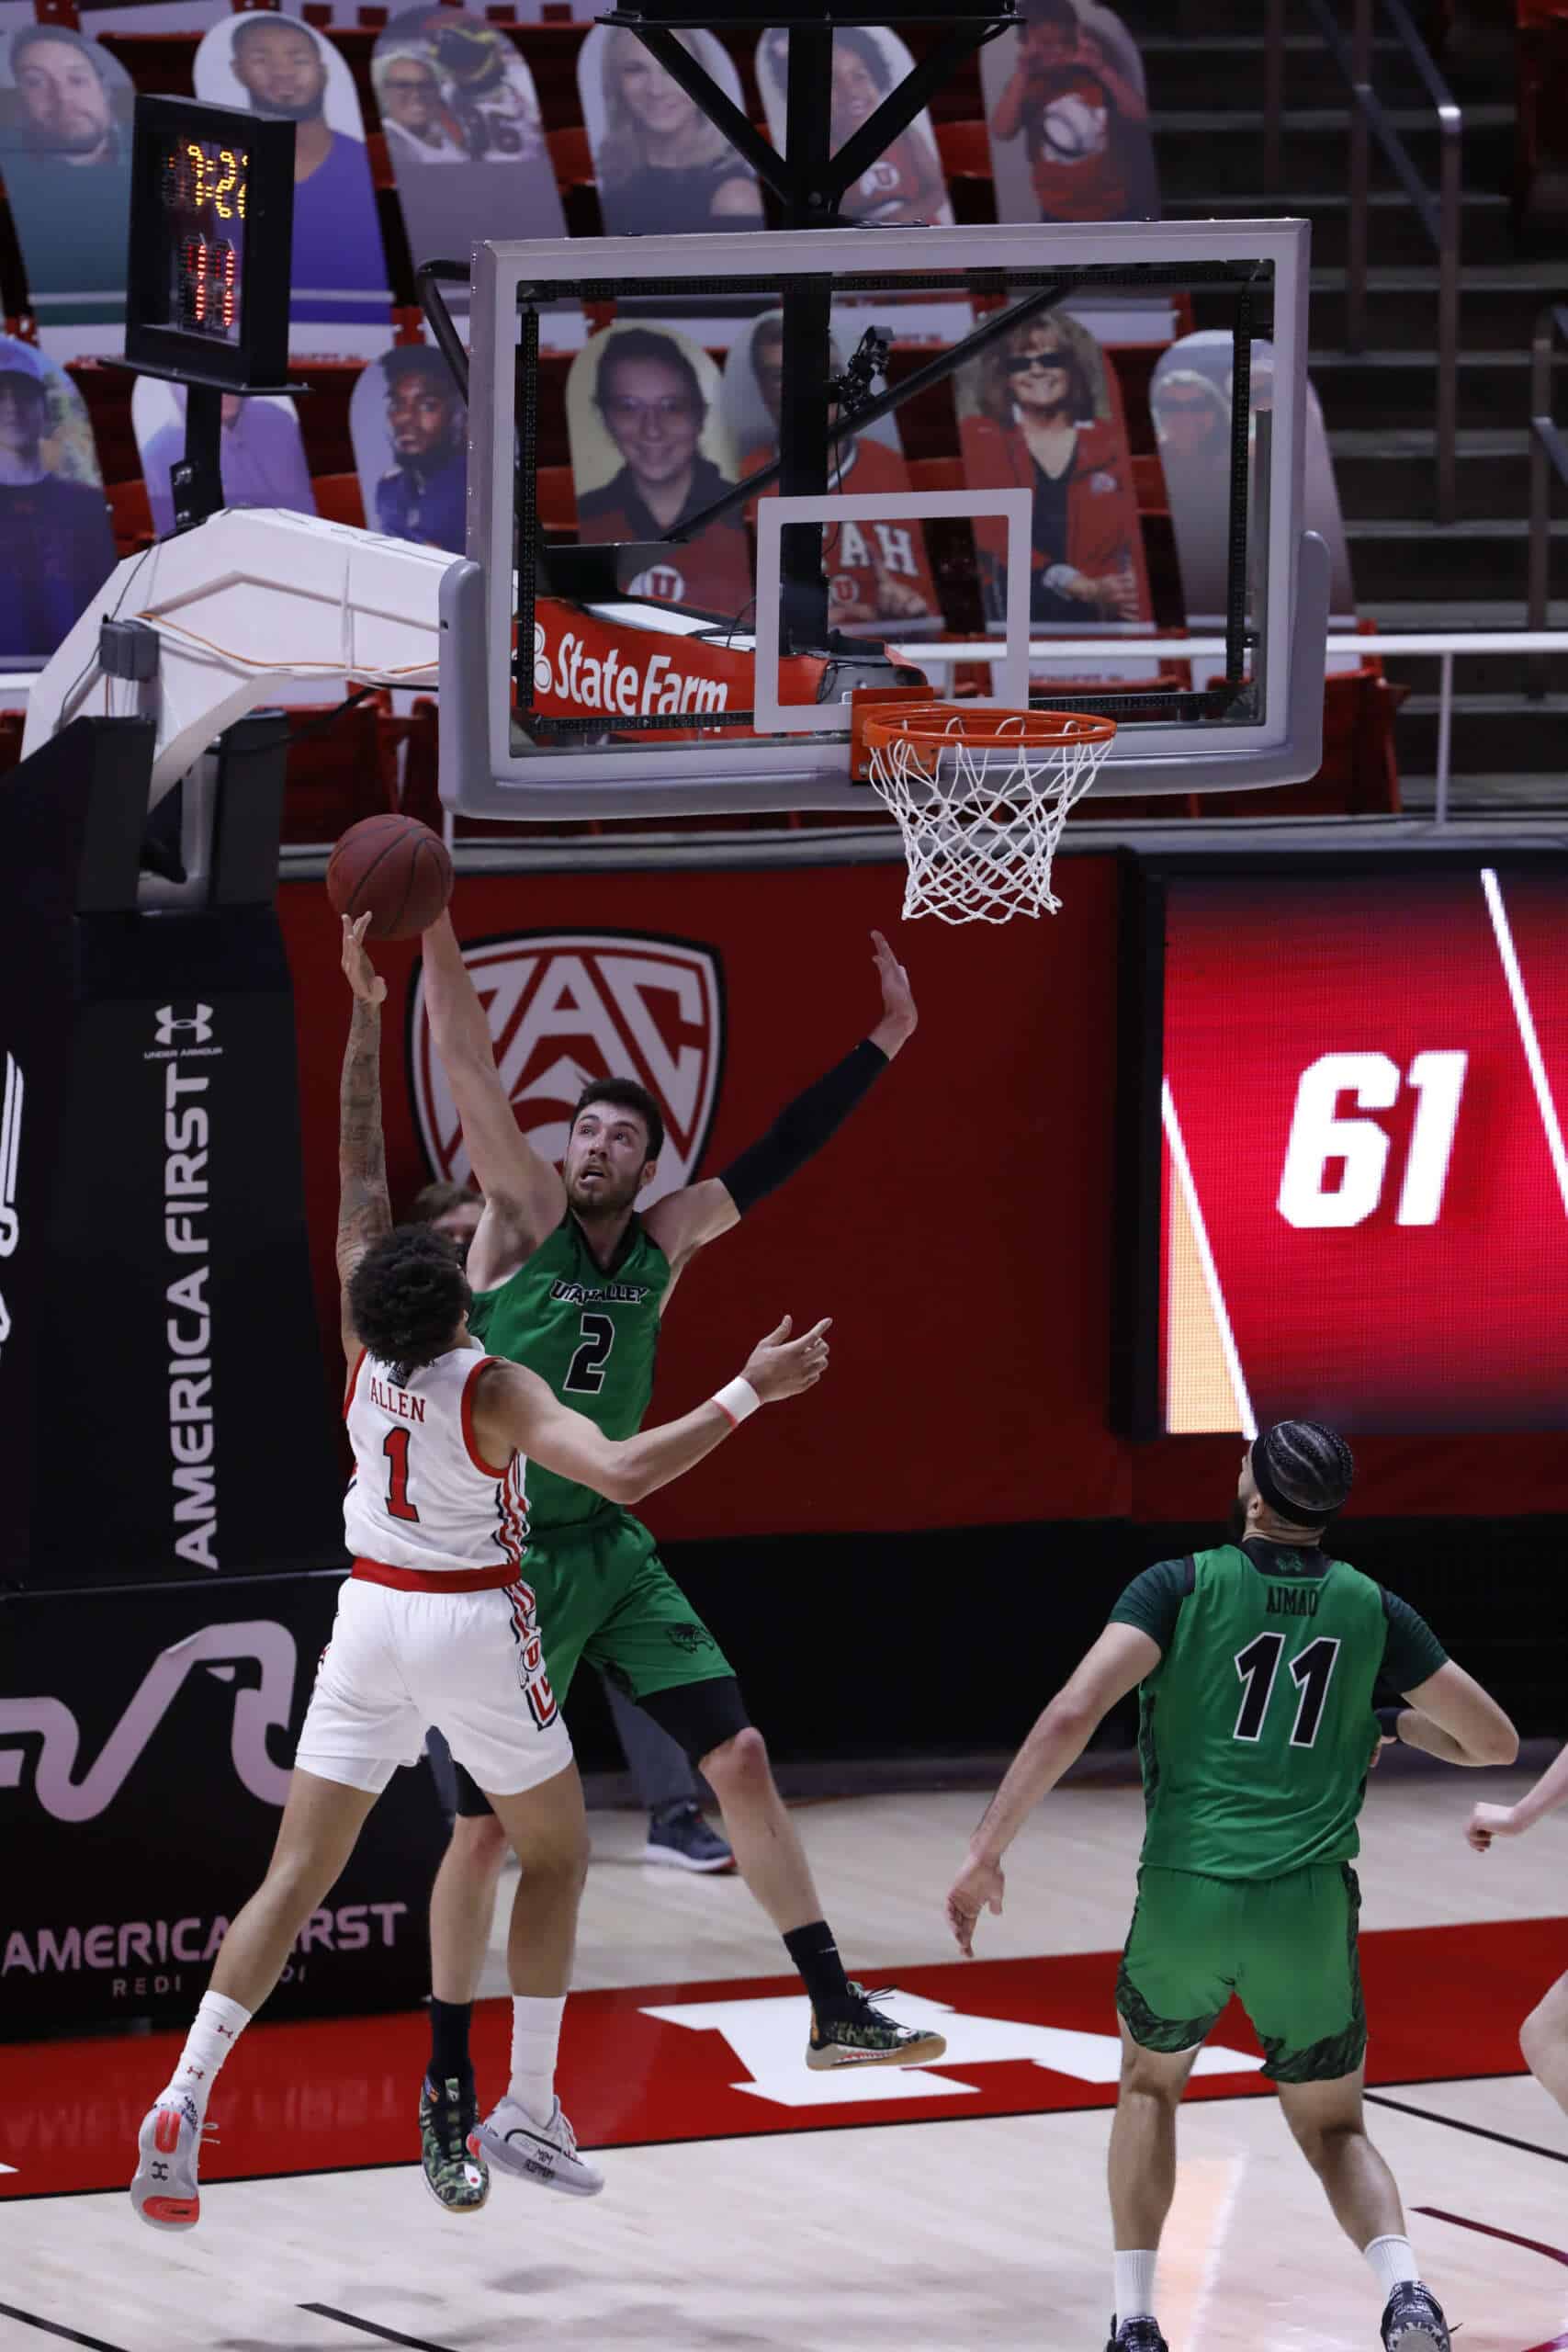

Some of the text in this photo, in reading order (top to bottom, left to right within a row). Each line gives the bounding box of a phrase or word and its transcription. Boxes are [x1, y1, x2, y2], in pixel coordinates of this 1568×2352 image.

[555, 631, 729, 717] State Farm
[1276, 1049, 1469, 1228] 61
[164, 1061, 219, 1571] AMERICA FIRST
[562, 1313, 615, 1394] 2
[370, 1377, 426, 1423] ALLEN
[383, 1425, 420, 1522] 1
[1233, 1632, 1342, 1748] 11
[290, 1902, 408, 1955] RST
